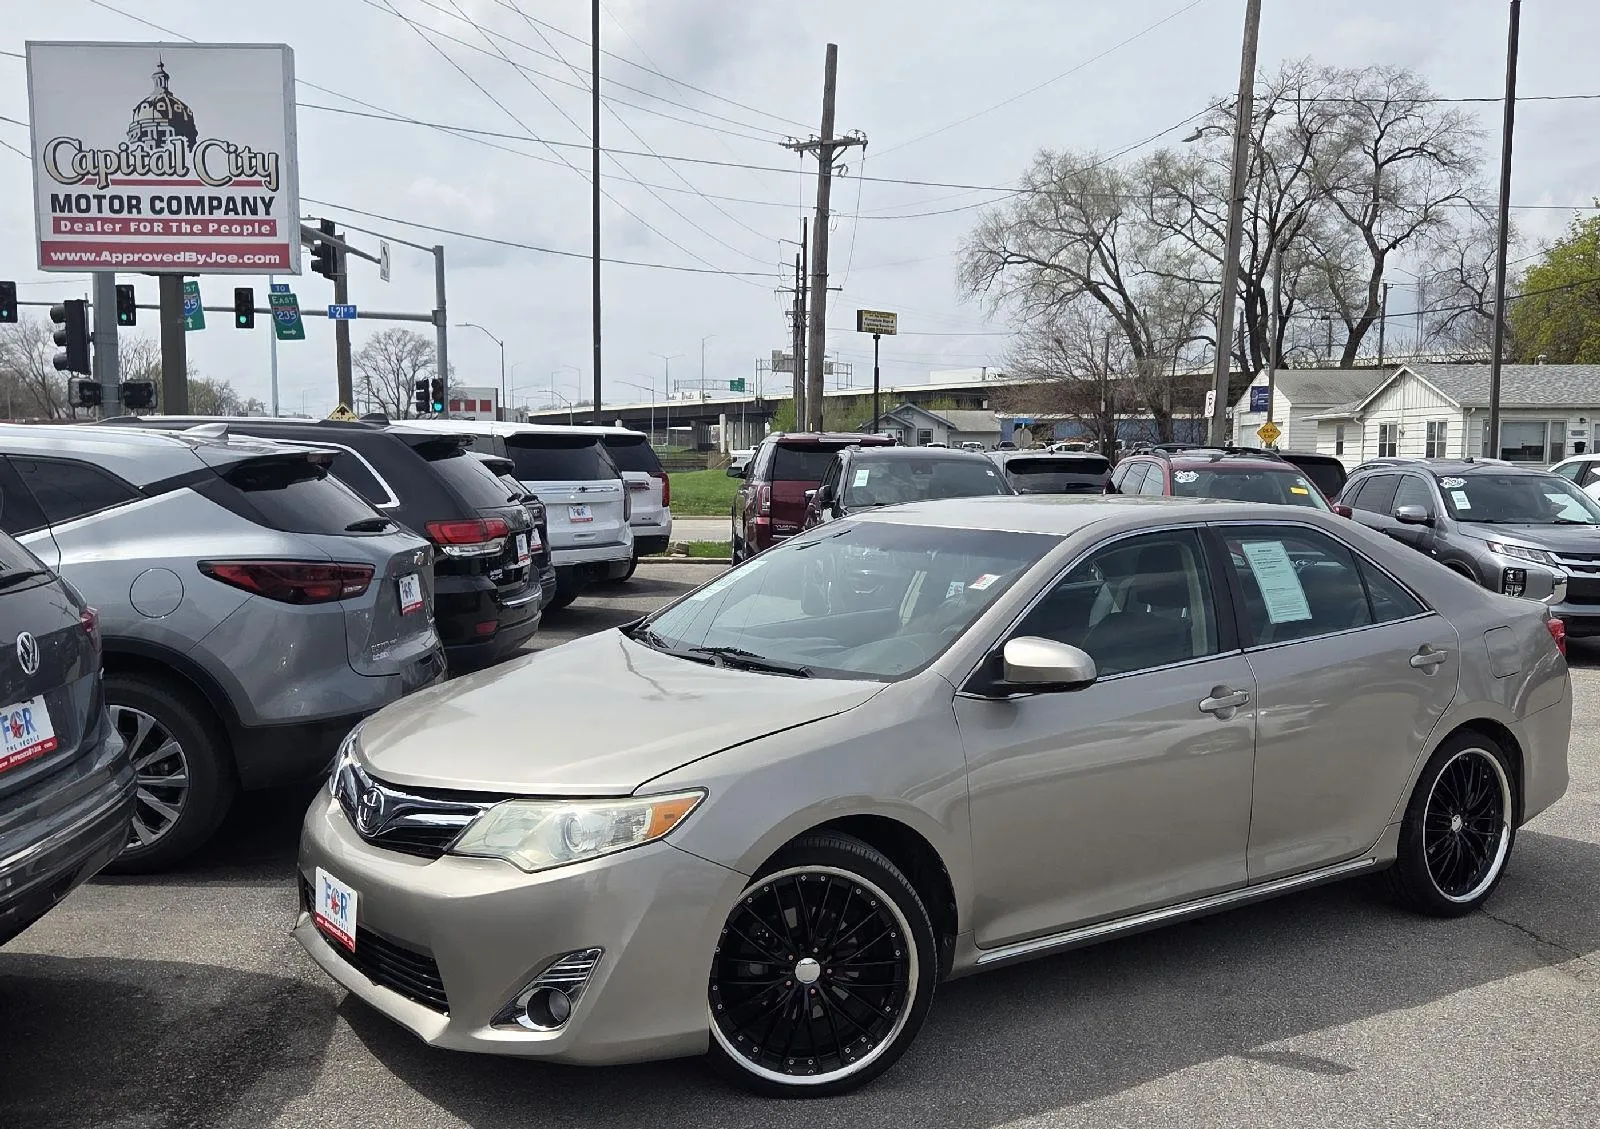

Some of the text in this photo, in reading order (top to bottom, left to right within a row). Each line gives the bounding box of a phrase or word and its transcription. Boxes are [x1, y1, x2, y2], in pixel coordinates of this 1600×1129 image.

[43, 136, 280, 192] Capital City
[50, 193, 275, 216] MOTOR COMPANY
[60, 220, 271, 235] Dealer FOR The People
[50, 250, 280, 265] www.ApprovedByJoe.com
[184, 300, 198, 309] 35
[272, 296, 294, 305] EAST
[277, 310, 297, 321] 235
[324, 881, 348, 922] FOR
